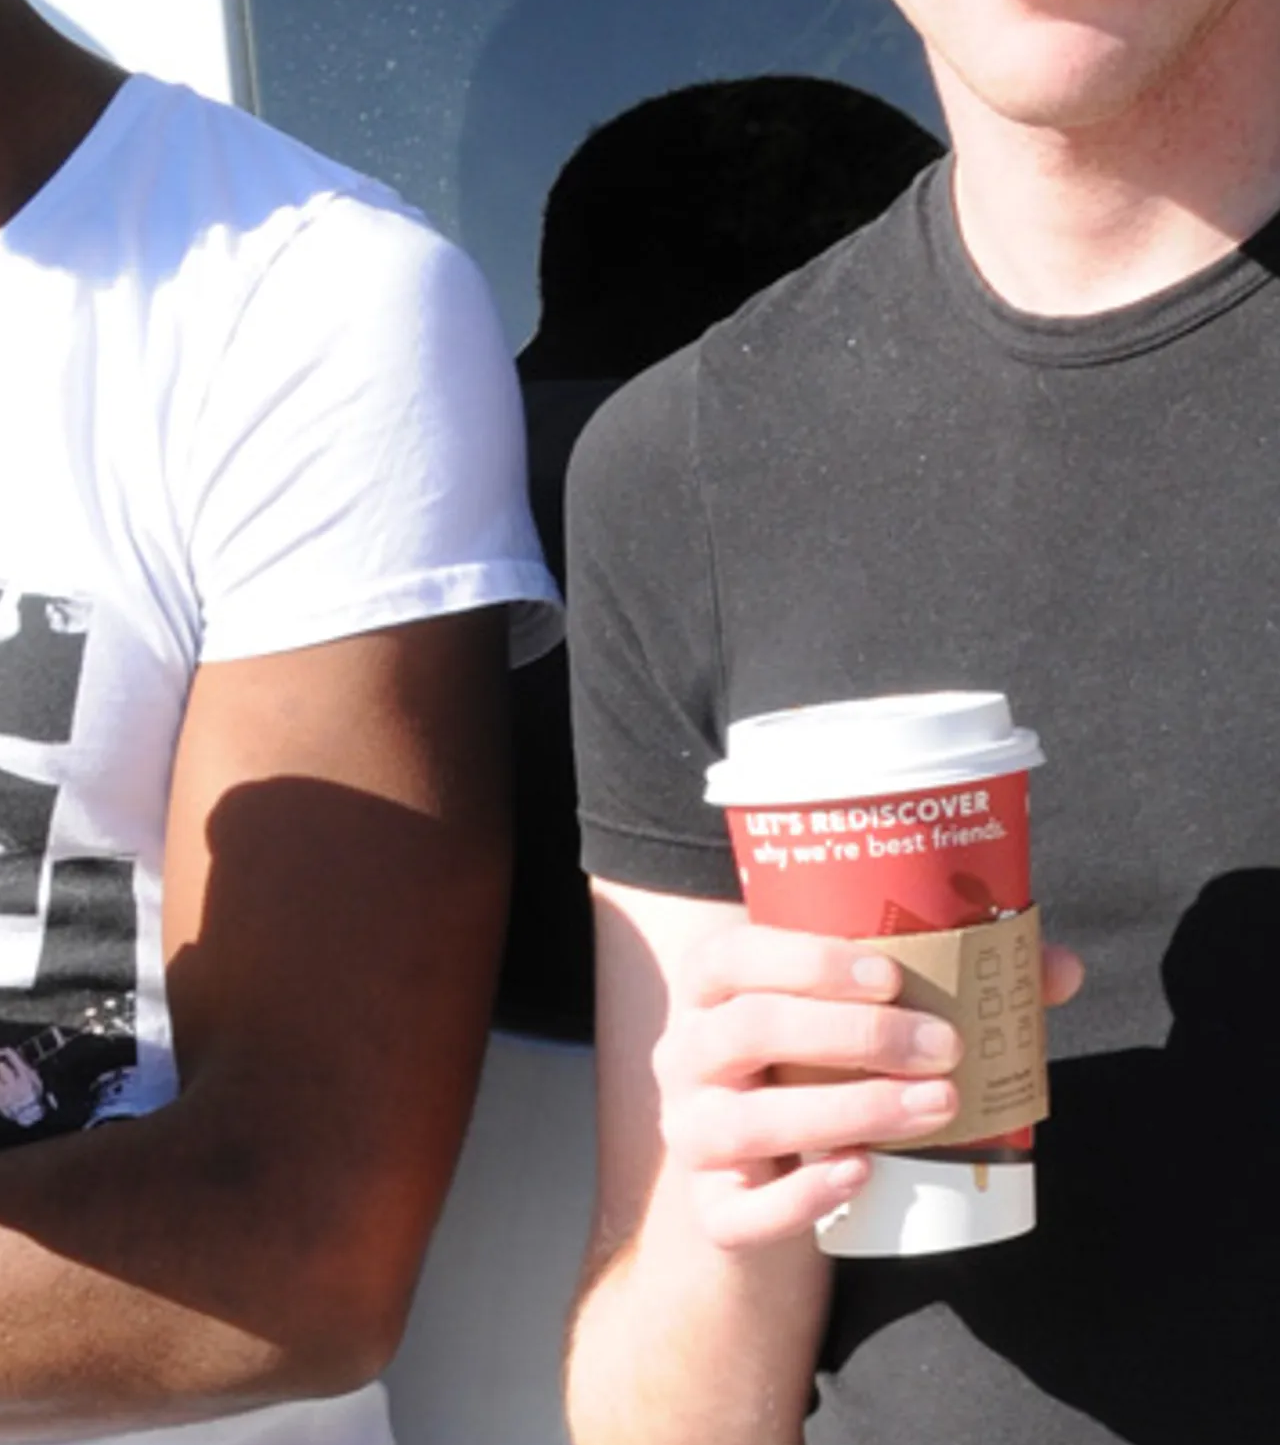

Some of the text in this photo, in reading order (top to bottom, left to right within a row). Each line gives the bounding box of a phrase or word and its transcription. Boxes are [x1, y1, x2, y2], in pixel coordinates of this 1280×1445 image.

[745, 790, 990, 836] LET'S REDISCOVER
[754, 840, 788, 871] why
[794, 838, 859, 863] we're
[866, 833, 925, 859] best
